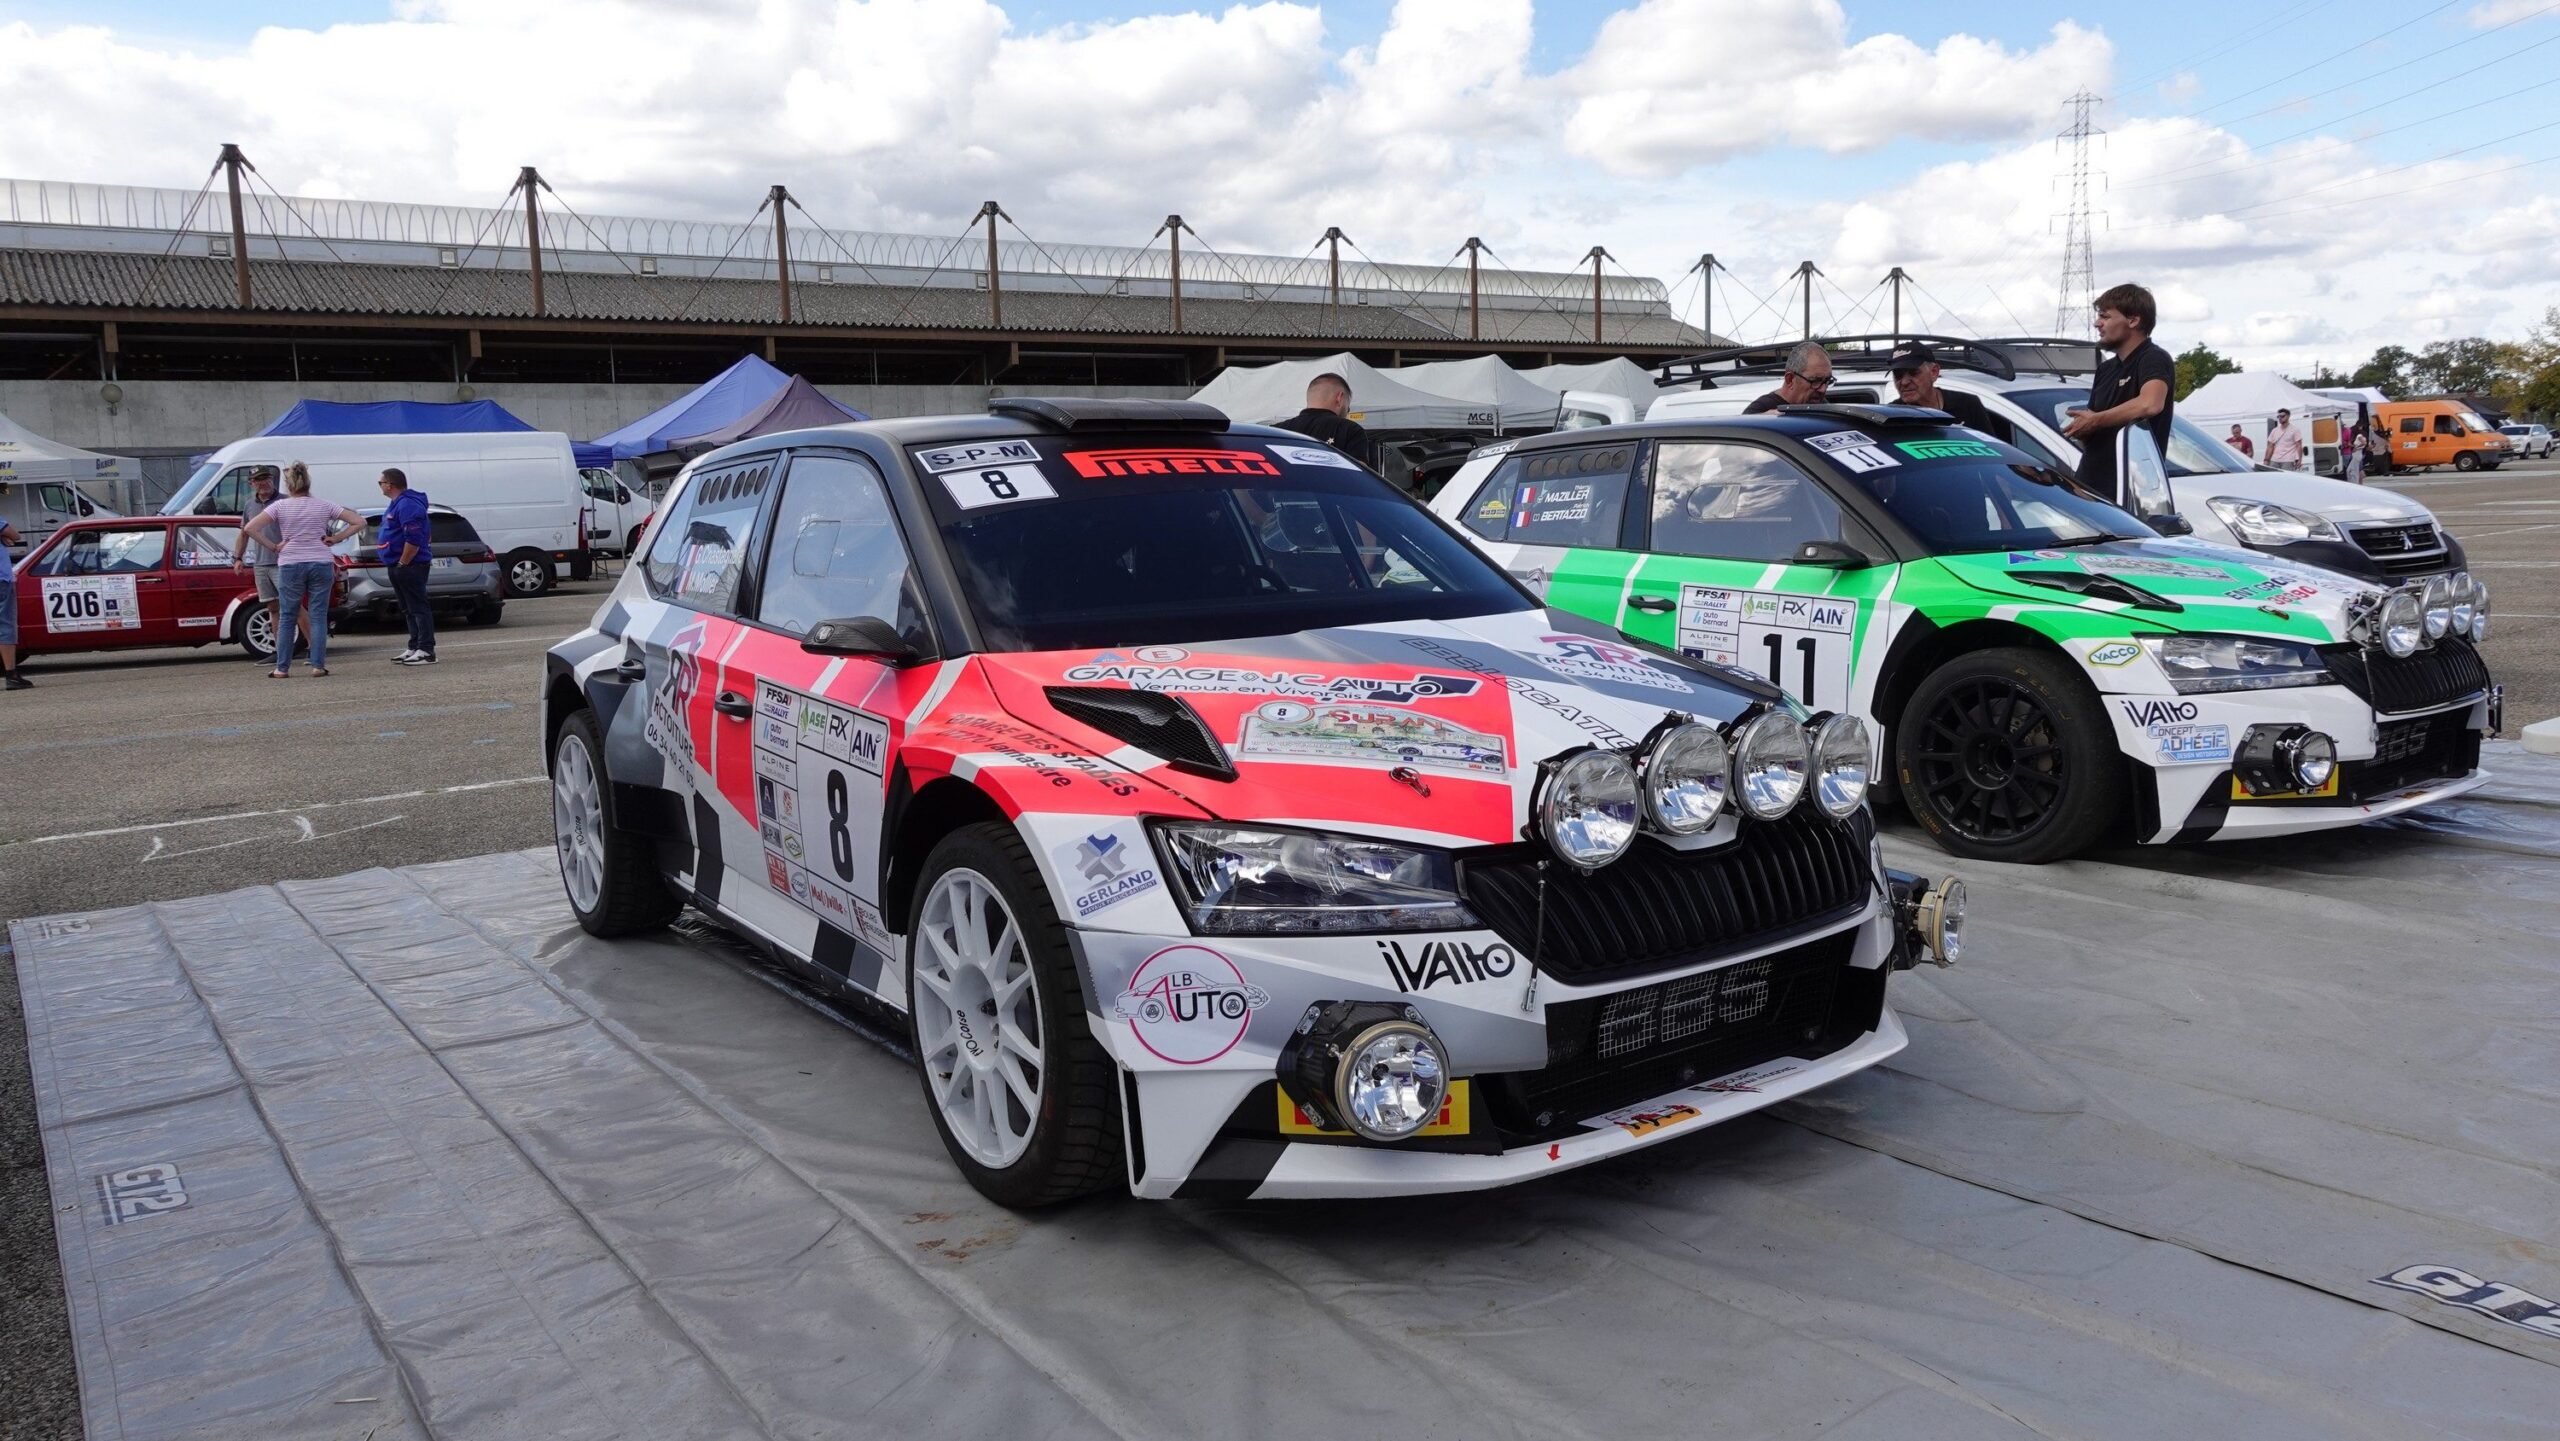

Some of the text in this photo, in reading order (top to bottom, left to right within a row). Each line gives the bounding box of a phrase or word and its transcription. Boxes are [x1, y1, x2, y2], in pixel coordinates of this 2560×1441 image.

[1468, 412, 1494, 422] MCB
[1815, 431, 1868, 449] S-P-M
[1893, 439, 2002, 460] PIRELLI
[931, 445, 1028, 465] S-P-M
[1062, 447, 1281, 478] PIRELLI
[980, 469, 1019, 499] 8
[1545, 489, 1590, 503] MAZILLER
[1541, 508, 1588, 521] BERTAZZO
[49, 591, 100, 618] 206
[1756, 601, 1777, 612] ASE
[1702, 619, 1728, 628] bernard
[1812, 607, 1843, 626] AIN
[1689, 633, 1729, 642] ALPINE
[2094, 645, 2137, 664] YACCO
[1068, 666, 1238, 682] GARAGE
[1545, 656, 1678, 683] RCTOITURE
[1551, 666, 1571, 675] 06
[1611, 673, 1633, 682] 40
[1639, 678, 1658, 686] 21
[1763, 633, 1816, 707] 11
[1134, 681, 1229, 693] Vernoux
[1275, 685, 1362, 700] Vivarais
[809, 711, 826, 729] ASE
[1277, 708, 1287, 716] 8
[647, 723, 658, 742] 06
[653, 694, 694, 764] RCTOITURE
[770, 723, 782, 735] auto
[829, 714, 849, 741] RX
[770, 733, 789, 749] bernard
[852, 729, 877, 761] AIN
[761, 754, 790, 773] ALPINE
[945, 713, 1140, 797] GARAGE DES STADES
[827, 769, 854, 883] 8
[1076, 869, 1153, 908] GERLAND
